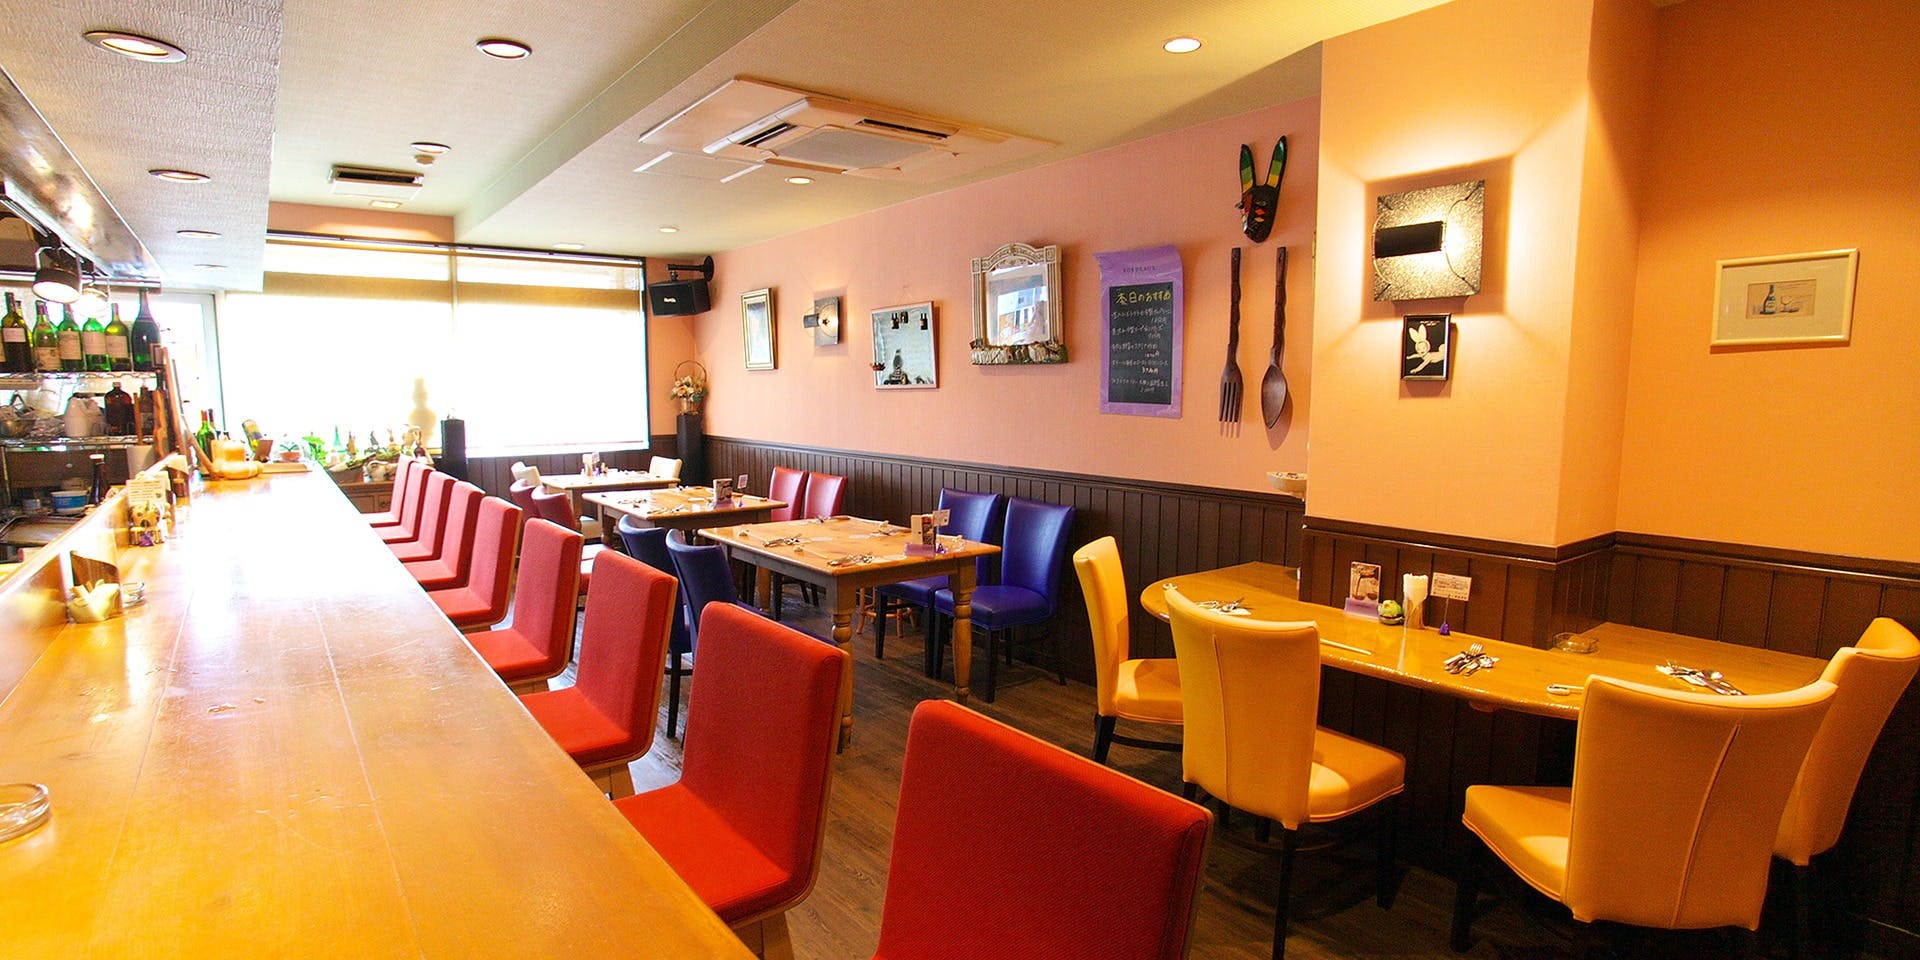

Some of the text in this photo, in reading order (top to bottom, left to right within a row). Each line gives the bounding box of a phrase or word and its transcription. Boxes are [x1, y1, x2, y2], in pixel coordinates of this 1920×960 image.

[1115, 290, 1171, 305] 本日のおすすめ
